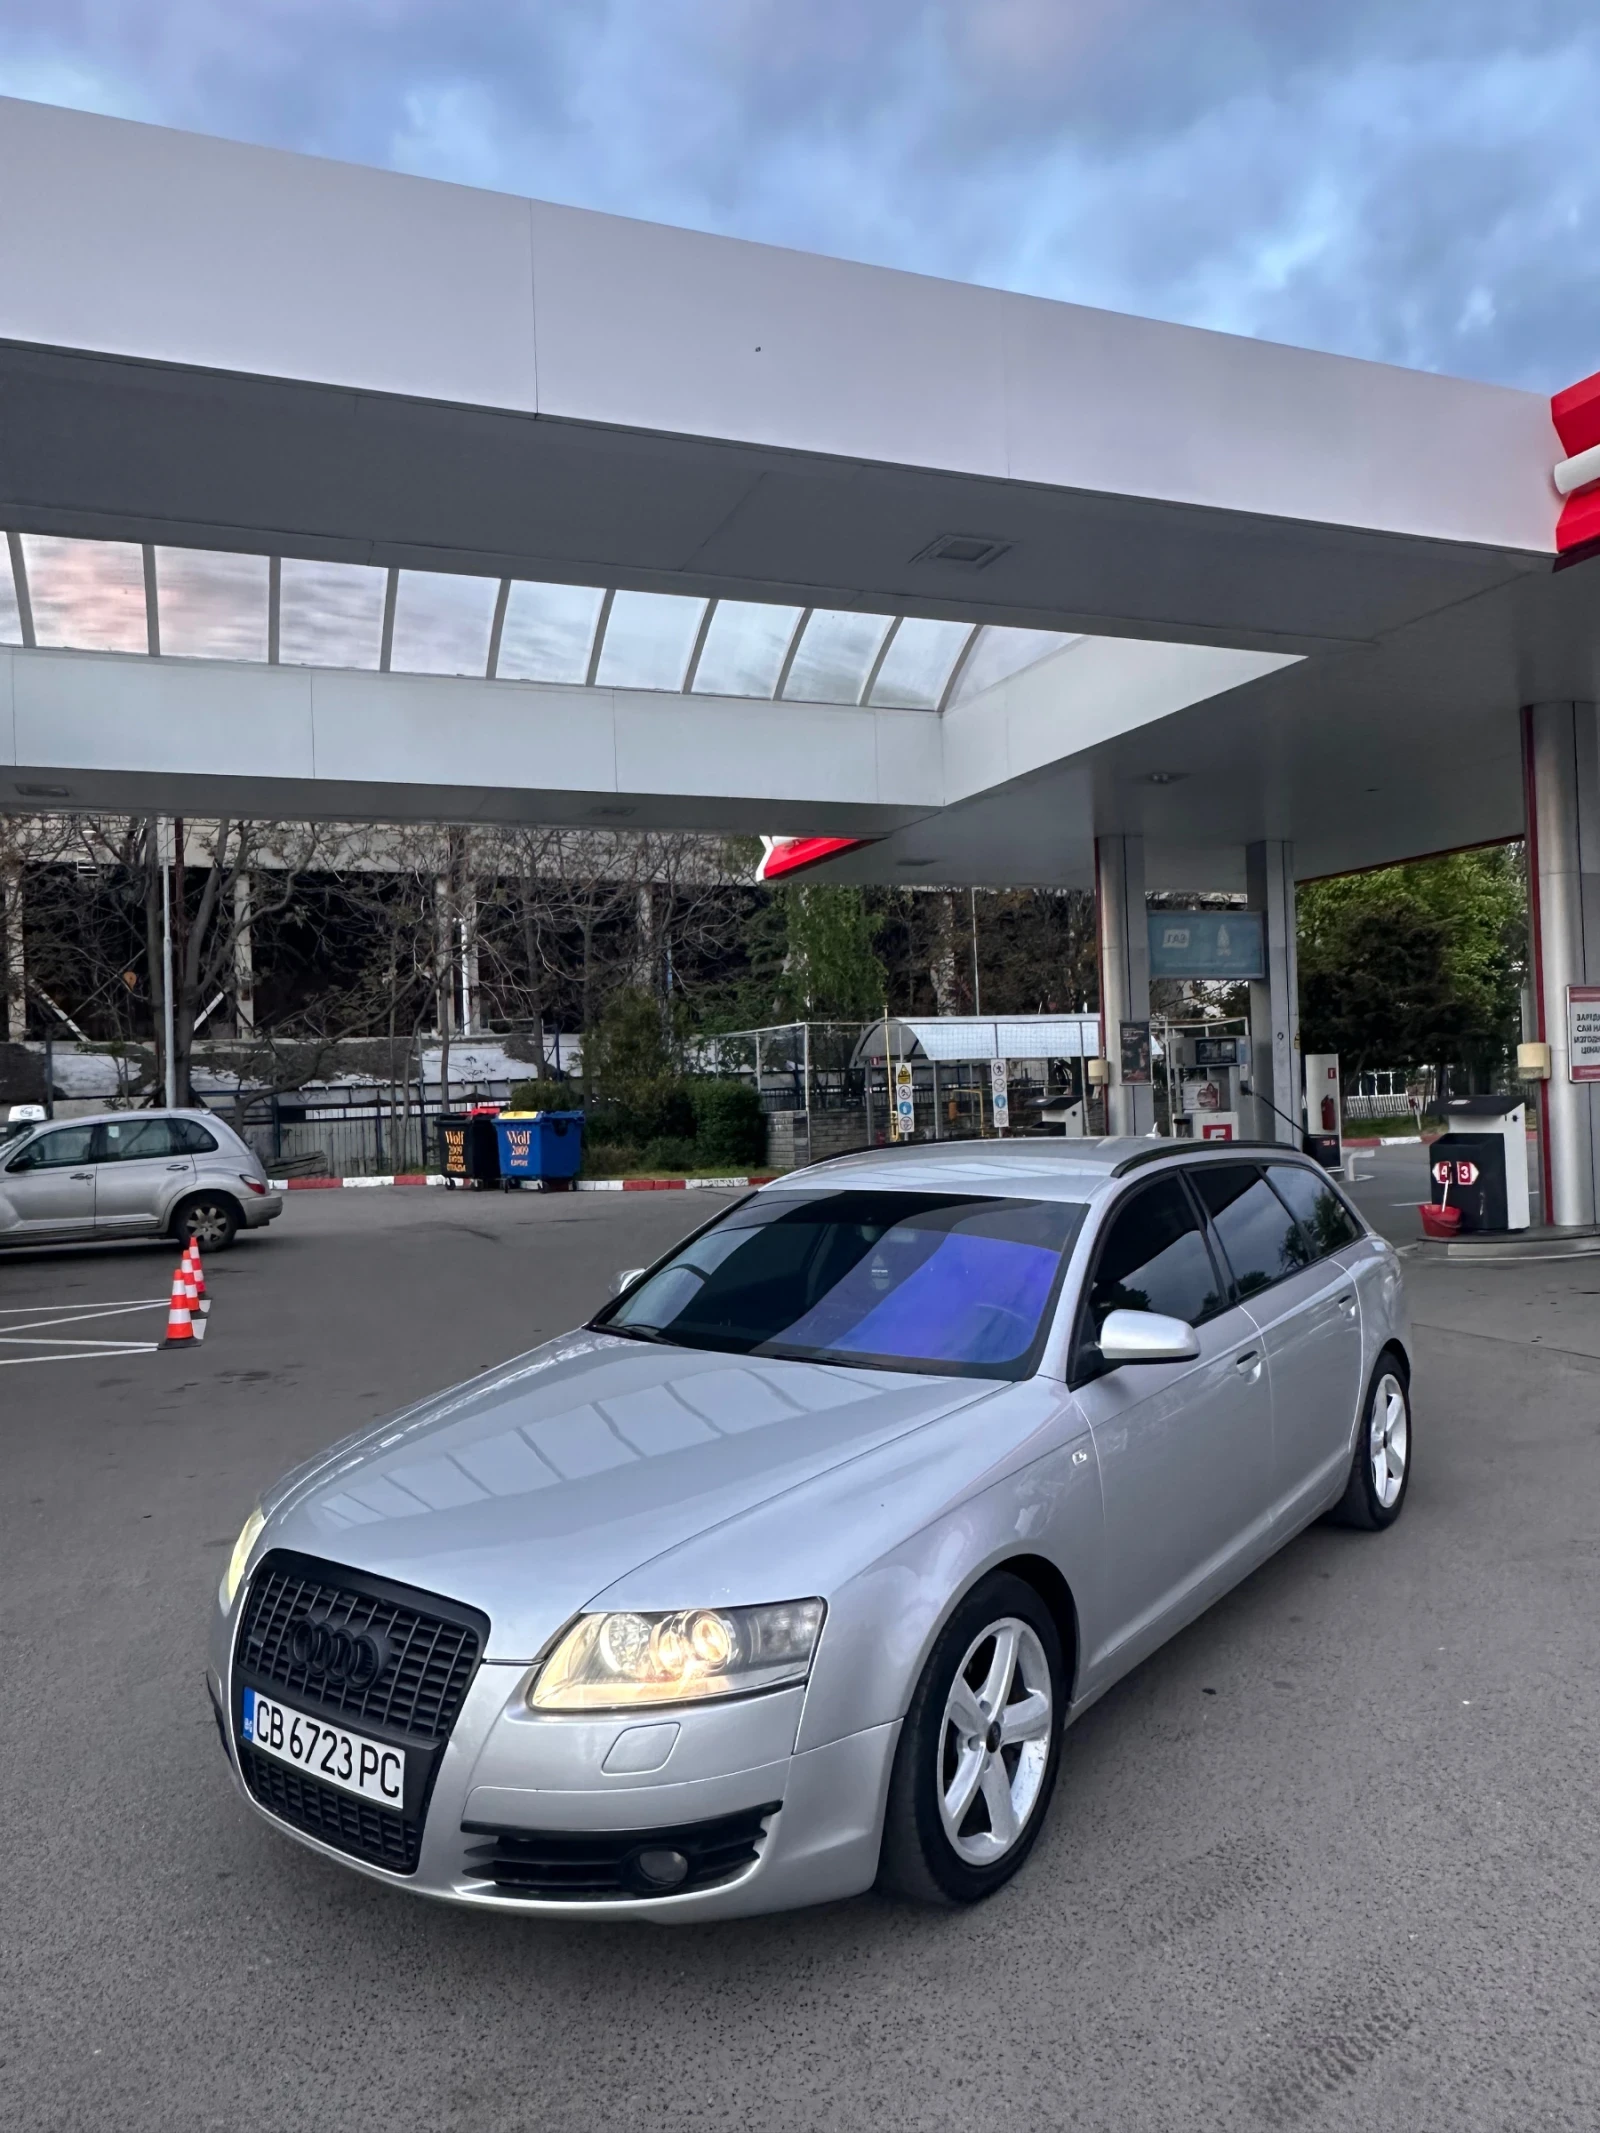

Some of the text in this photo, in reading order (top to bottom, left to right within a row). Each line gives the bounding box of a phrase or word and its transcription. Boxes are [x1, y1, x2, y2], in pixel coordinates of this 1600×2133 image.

[445, 1131, 464, 1145] Wolf
[506, 1130, 532, 1145] Wolf
[511, 1145, 529, 1156] 2009
[1441, 1165, 1448, 1178] 4
[1460, 1165, 1469, 1180] 3
[256, 1700, 401, 1798] CB 6723 PC
